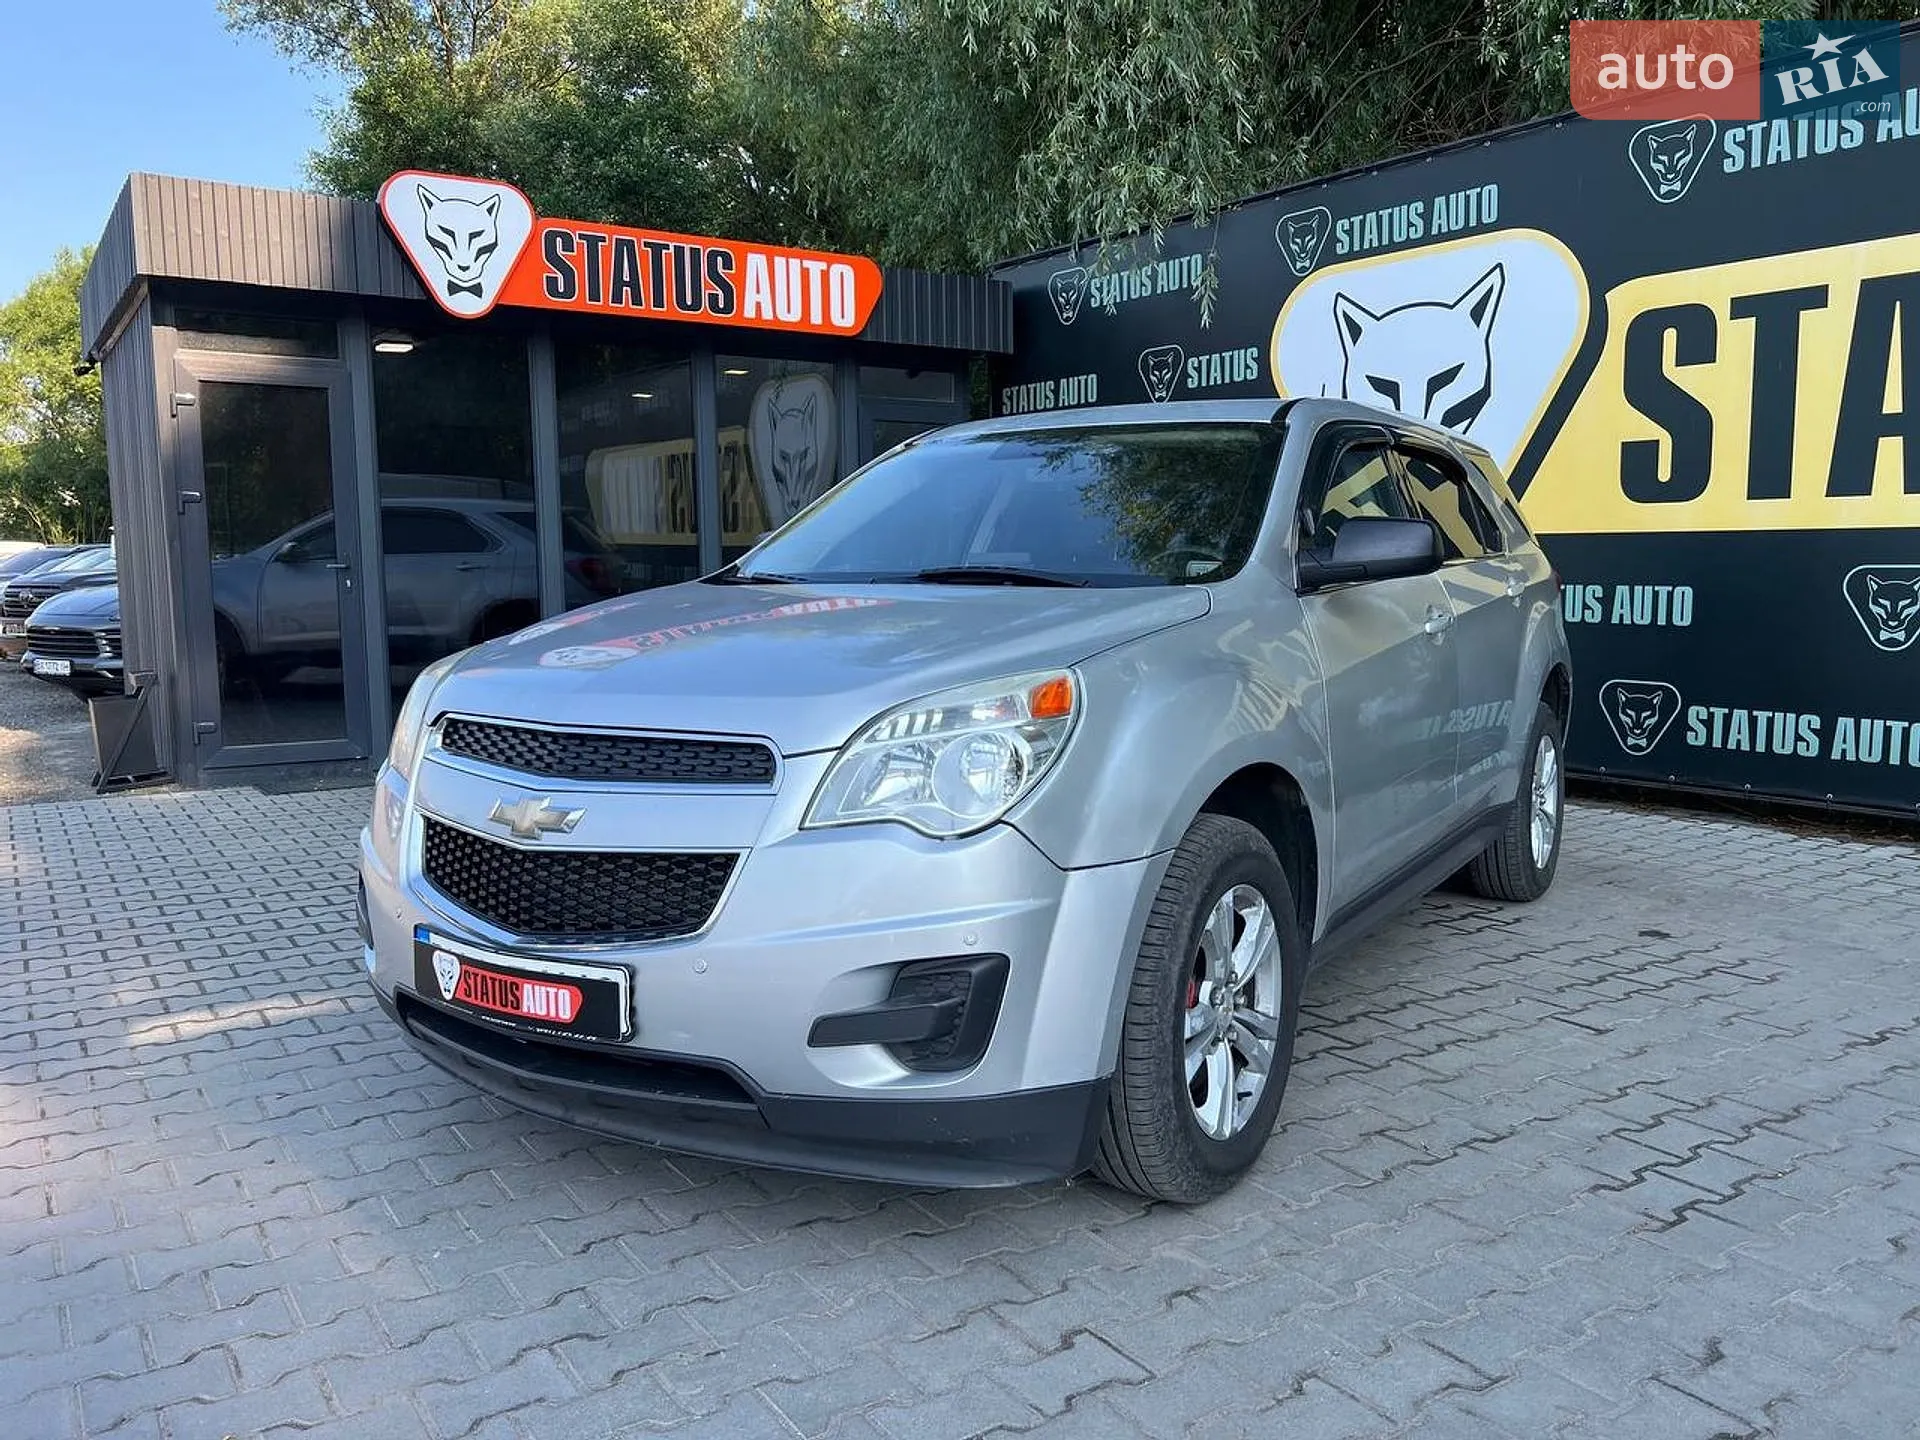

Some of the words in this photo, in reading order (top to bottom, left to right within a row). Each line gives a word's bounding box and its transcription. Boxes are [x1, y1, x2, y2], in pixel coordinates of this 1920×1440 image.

[1723, 101, 1864, 173] STATUS
[1336, 201, 1424, 255] STATUS
[1431, 184, 1498, 235] AUTO
[541, 228, 736, 317] STATUS
[743, 253, 856, 328] AUTO
[1090, 263, 1152, 308] STATUS
[1156, 253, 1202, 294] AUTO
[1002, 380, 1054, 415] STATUS
[1059, 373, 1098, 406] AUTO
[1186, 347, 1259, 389] STATUS
[1560, 584, 1603, 624] US
[1611, 585, 1693, 627] AUTO
[1686, 705, 1821, 757] STATUS
[463, 969, 520, 1011] STATUS
[523, 983, 571, 1020] AUTO
